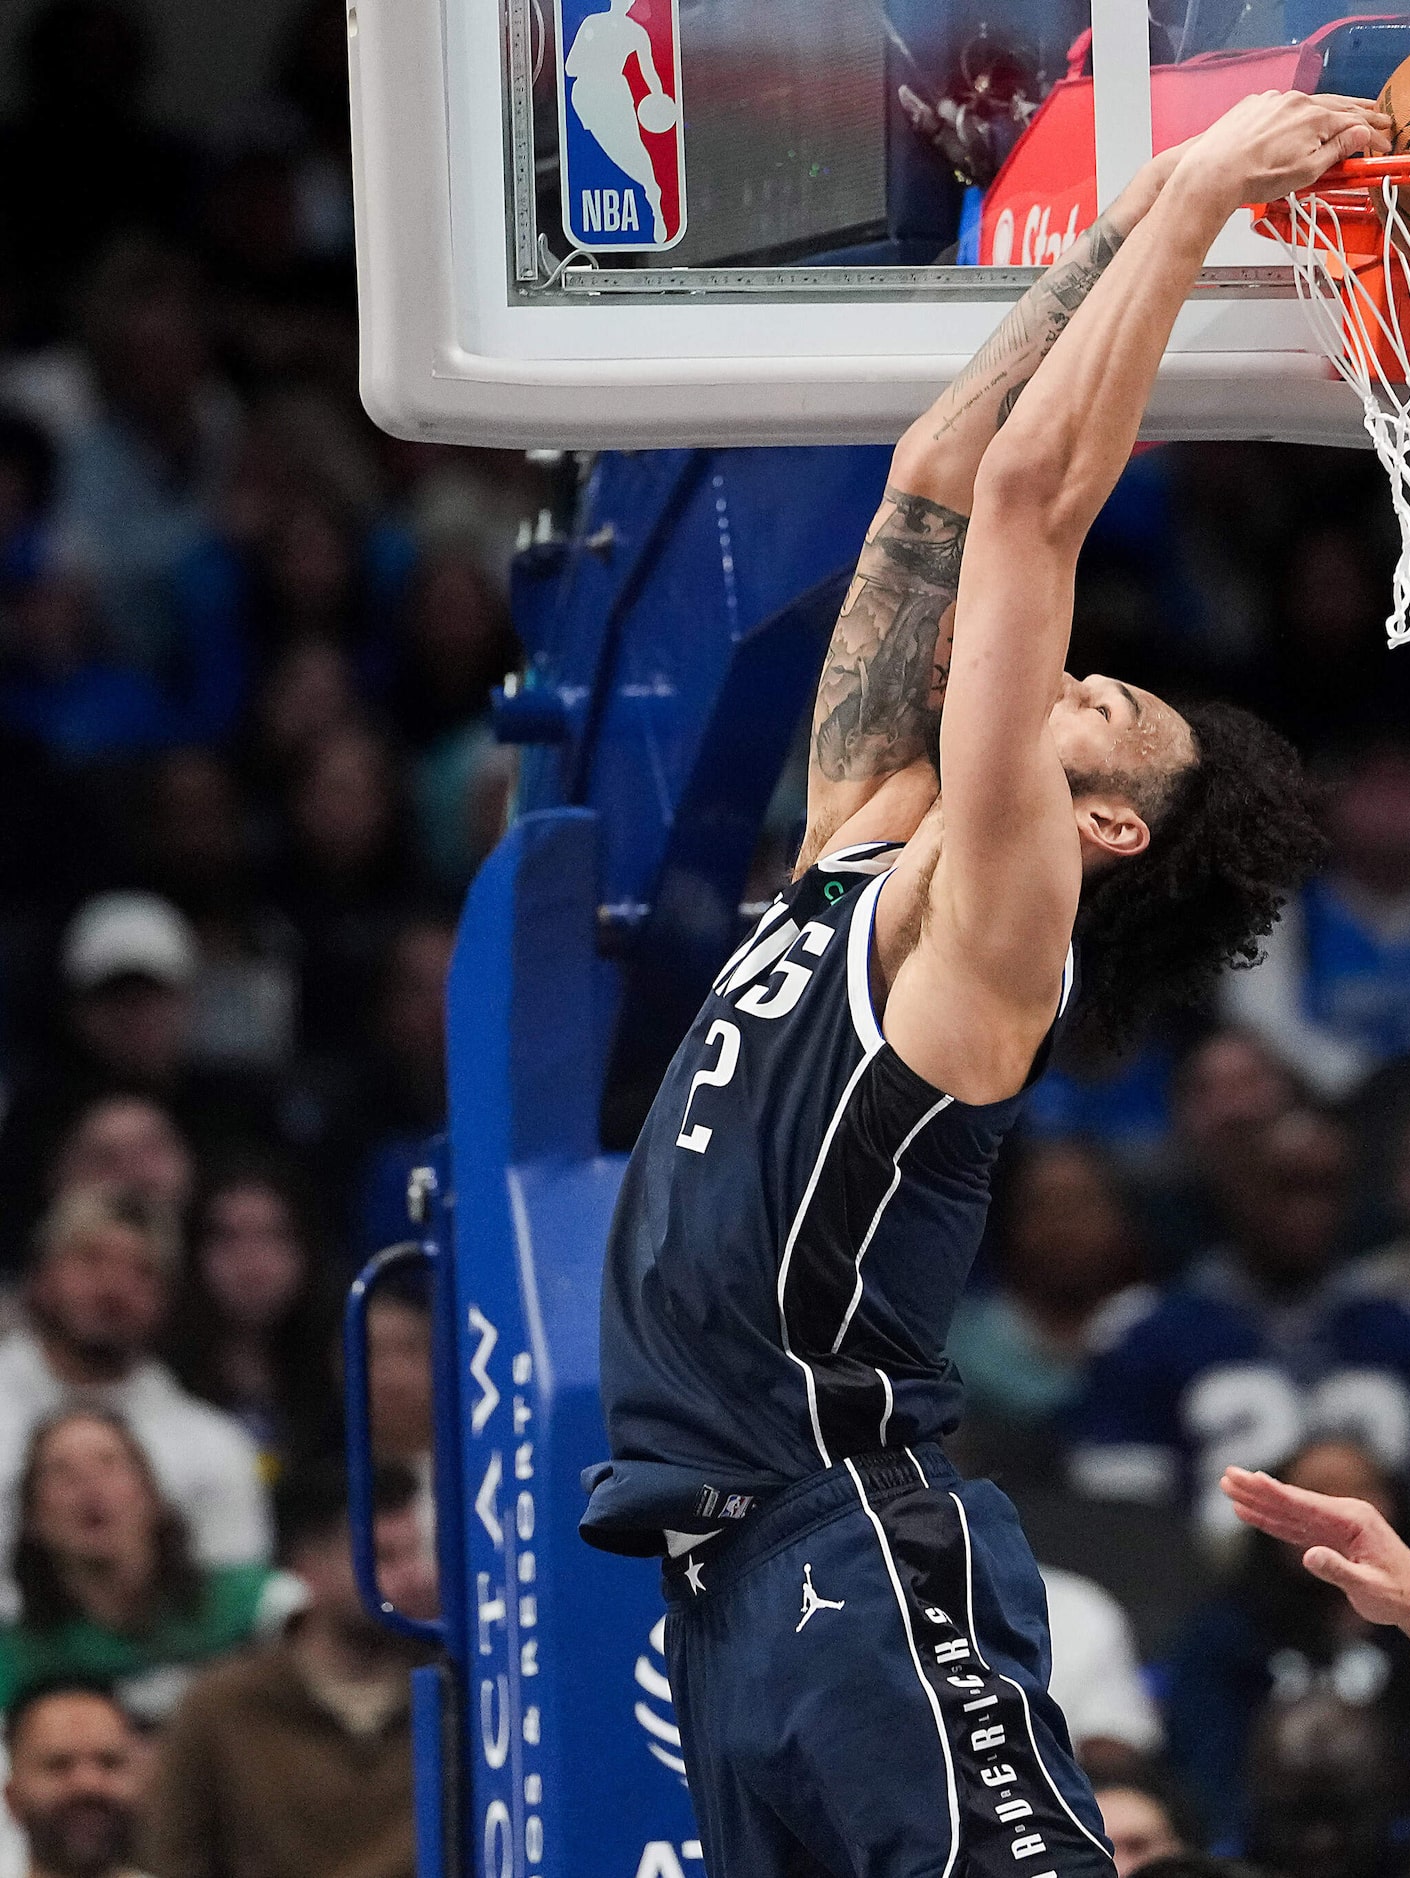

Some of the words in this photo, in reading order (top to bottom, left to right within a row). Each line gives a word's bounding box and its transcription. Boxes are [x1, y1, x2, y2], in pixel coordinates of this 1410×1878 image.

[581, 188, 640, 232] NBA
[1021, 203, 1086, 266] Stat
[676, 1019, 741, 1154] 2
[924, 1607, 1057, 1878] AVERICKS
